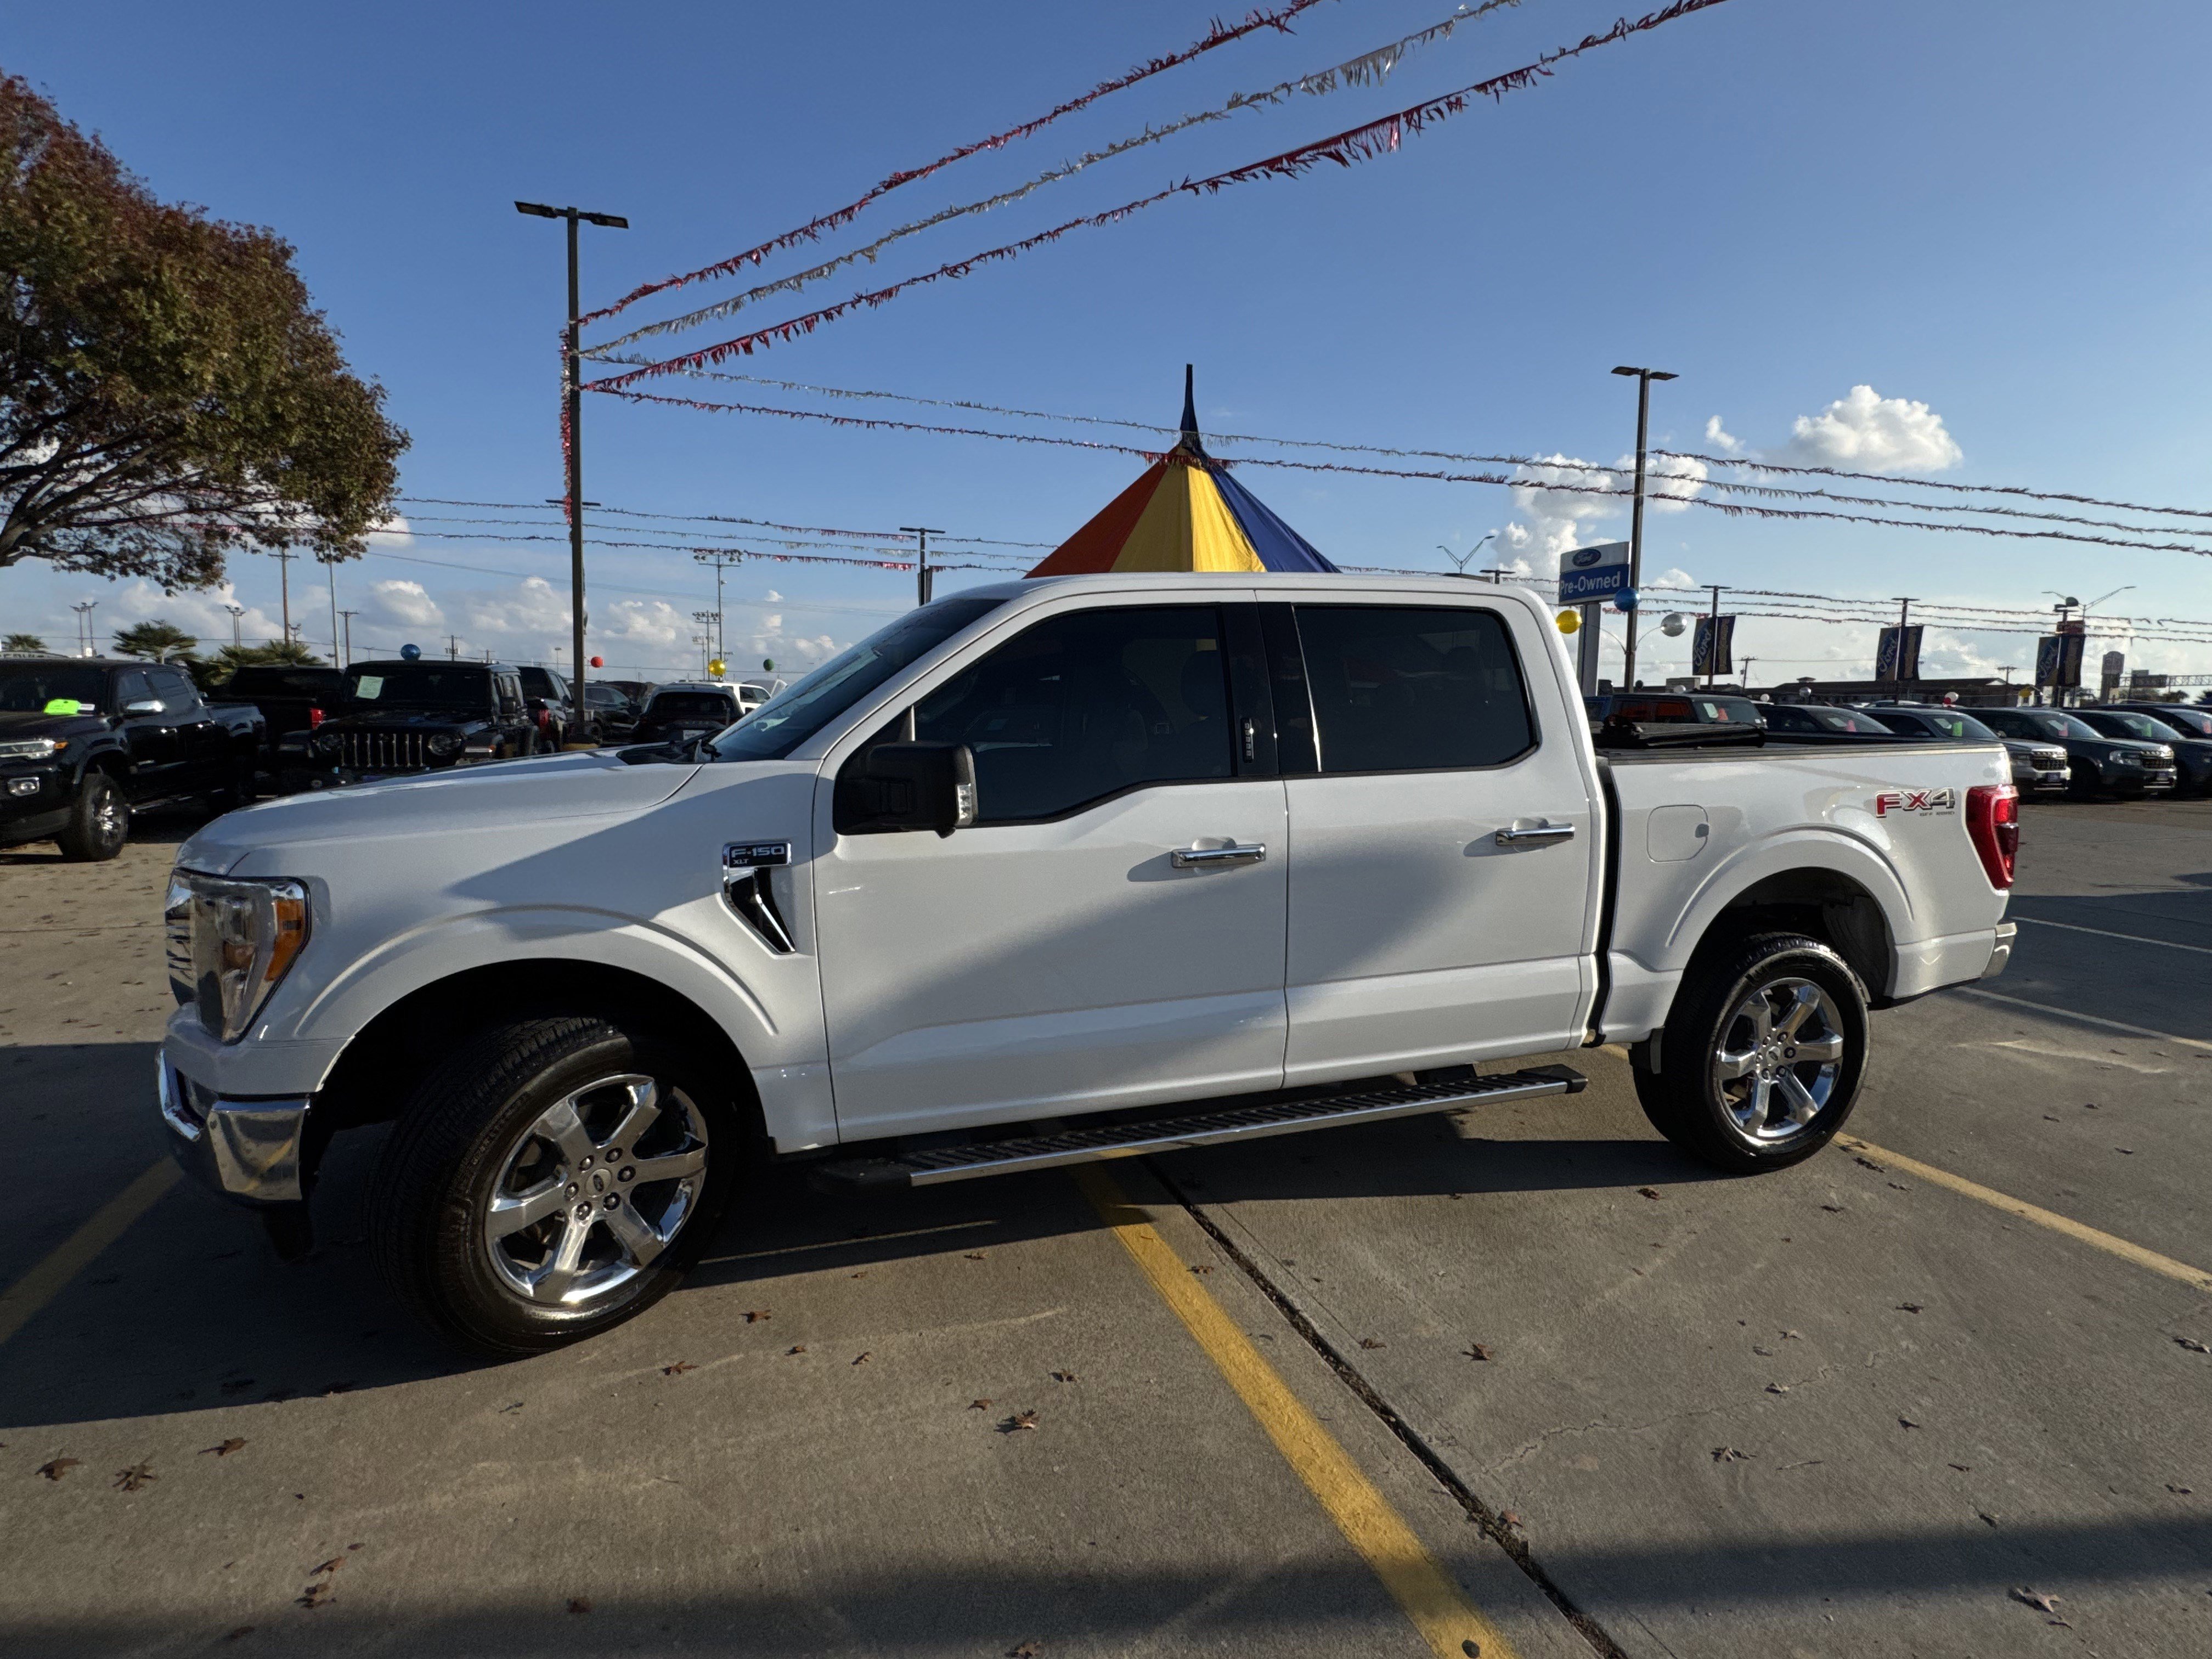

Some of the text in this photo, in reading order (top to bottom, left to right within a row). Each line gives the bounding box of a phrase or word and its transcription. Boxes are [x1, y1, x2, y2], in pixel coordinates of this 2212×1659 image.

[1560, 571, 1621, 595] Pre-Owned
[1694, 628, 1712, 667] Ford
[1875, 787, 1955, 818] FX4
[731, 845, 785, 858] F-150
